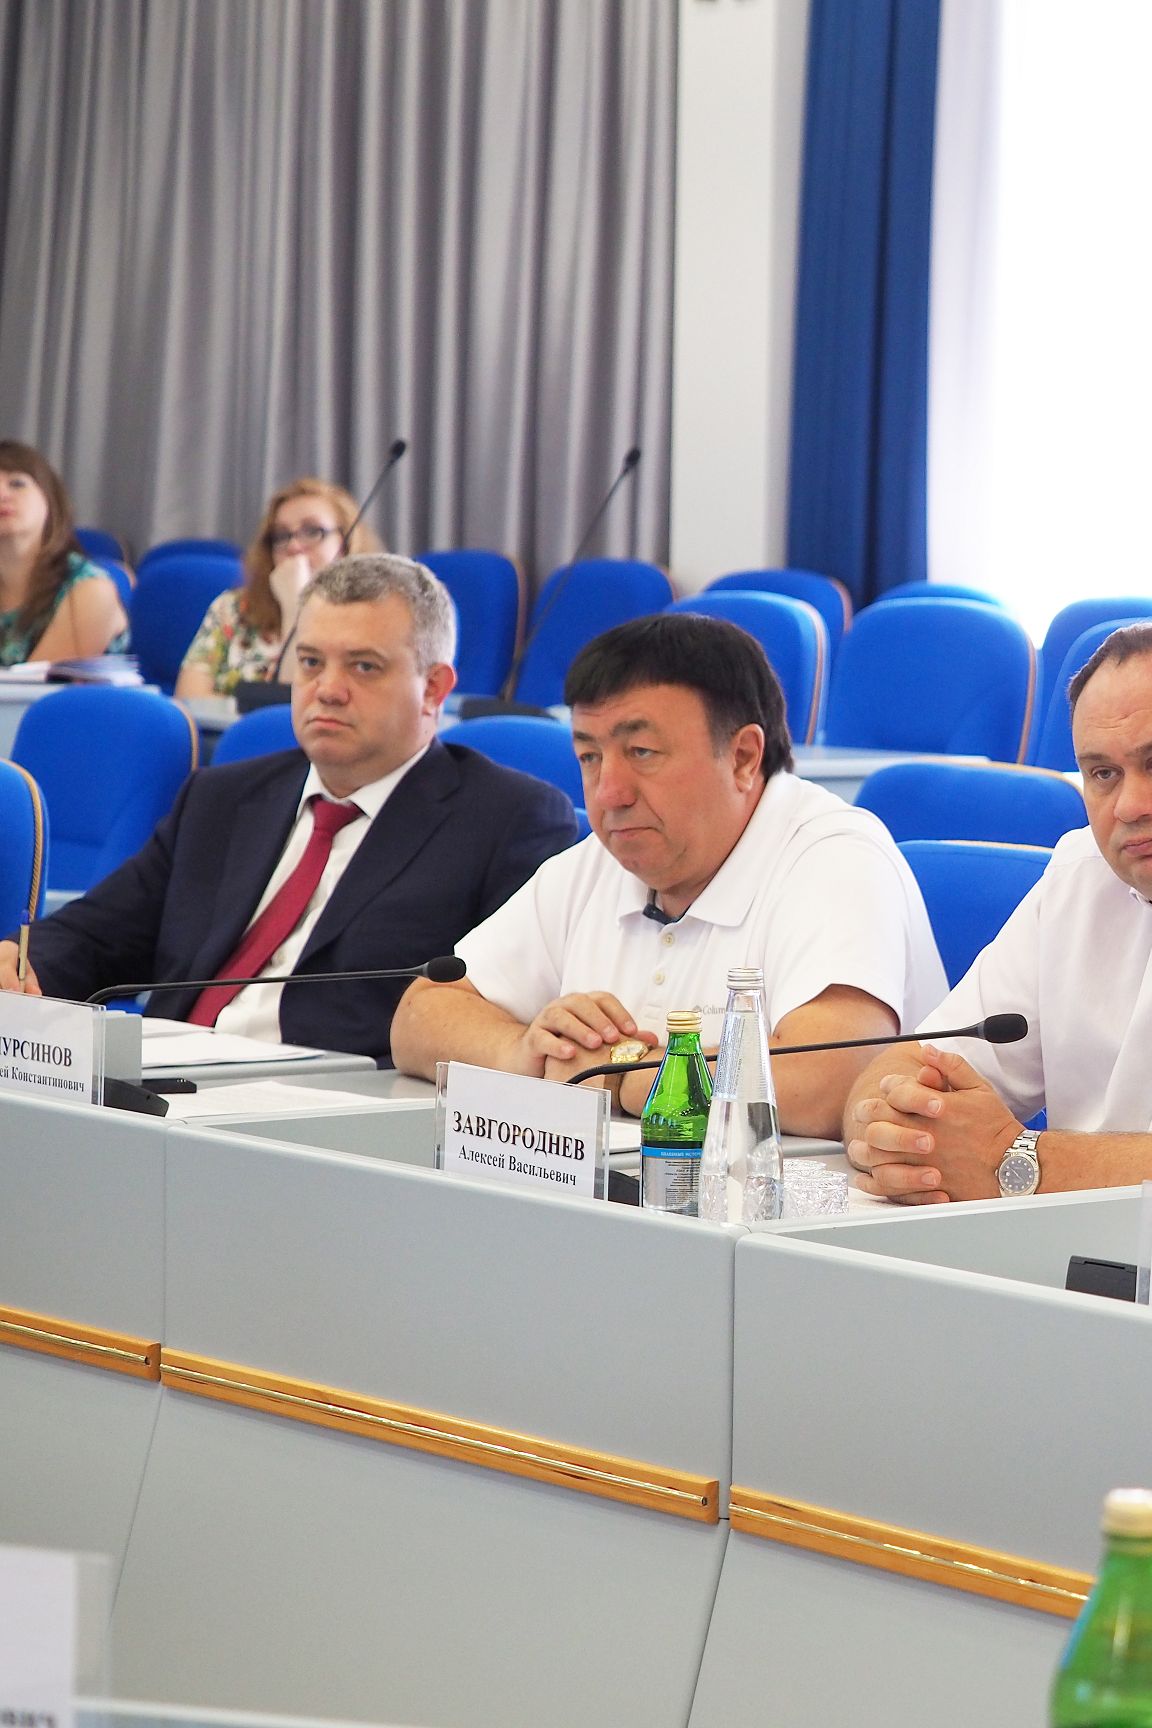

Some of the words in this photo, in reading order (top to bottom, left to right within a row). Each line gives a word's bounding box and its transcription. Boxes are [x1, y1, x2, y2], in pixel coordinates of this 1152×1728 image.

[0, 1036, 72, 1067] УРСИНОВ
[12, 1066, 84, 1092] Константинович
[453, 1111, 585, 1160] ЗАВГОРОДНЕВ
[459, 1145, 505, 1169] Алексей
[508, 1155, 576, 1186] Васильевич
